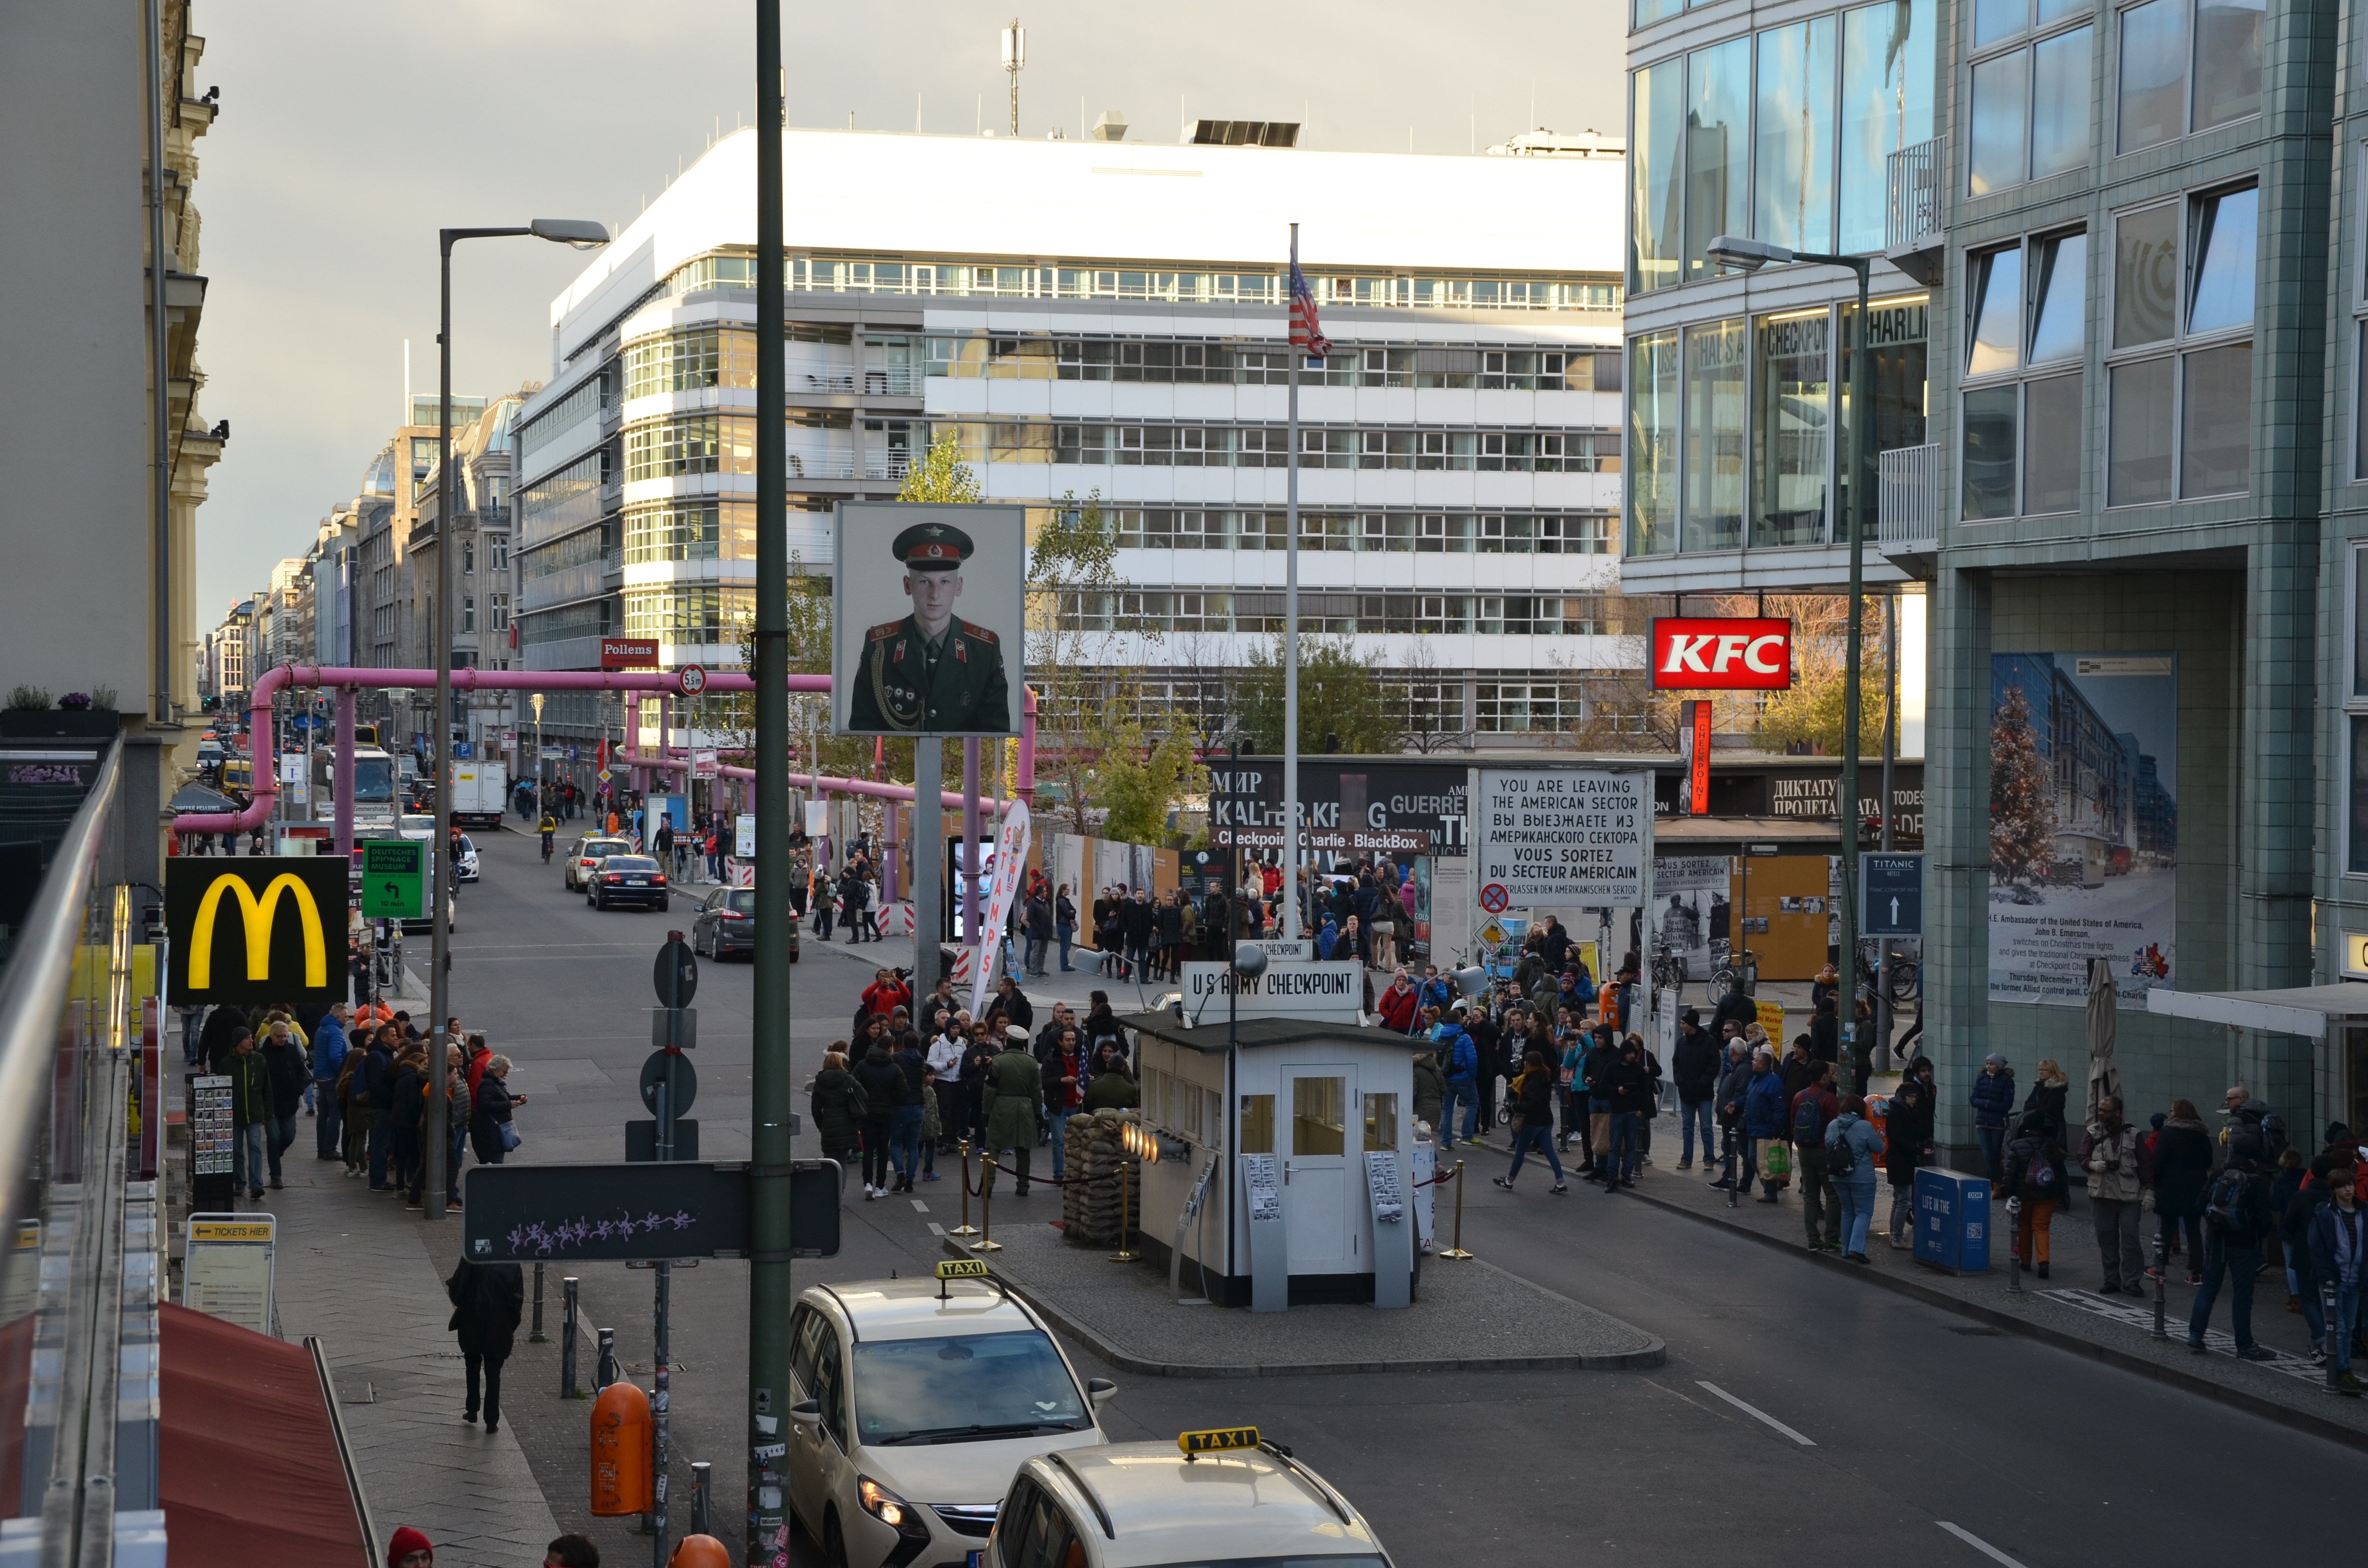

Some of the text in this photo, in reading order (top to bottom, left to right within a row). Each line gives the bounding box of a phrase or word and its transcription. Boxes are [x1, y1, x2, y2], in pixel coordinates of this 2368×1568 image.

[1768, 317, 1828, 356] CHECKPOI
[1866, 305, 1928, 344] HARLI
[604, 644, 652, 655] Pollems
[1660, 635, 1785, 674] KFC
[1695, 724, 1705, 801] CHECKPOINT
[1211, 772, 1262, 793] МИР
[1500, 779, 1631, 794] YOU ARE LEAVING
[1774, 779, 1837, 801] ДИКТАТУ
[1391, 795, 1464, 814] GUERRE
[1492, 796, 1638, 810] THE AMERICAN SECTOR
[1893, 790, 1924, 805] TODES
[1775, 798, 1881, 814] ПРОЛЕТААТА
[1493, 814, 1634, 828] ВЫ ВЫЕЗЖАЕТЕ ИЗ
[1219, 831, 1284, 848] Ceckpoin
[1354, 834, 1418, 848] BlackBox
[1490, 831, 1638, 844] АМЕРИКАНСКОГО СЕКТОРА
[1514, 848, 1613, 862] VOUS SORTEZ
[1490, 864, 1637, 879] DU SECTEUR AMÉRICAIN
[1682, 860, 1710, 869] SORTEZ
[1657, 868, 1724, 879] SECTEUR AMÉRICAIN
[1504, 885, 1637, 894] ERLASSEN DEN AMERIKANISCHEN SEKTOR
[982, 826, 1011, 973] STAMPS
[2001, 915, 2038, 925] Ambassador
[2060, 918, 2081, 926] United
[2083, 919, 2103, 927] States
[2113, 920, 2144, 930] America,
[1415, 921, 1430, 942] WAR
[2035, 928, 2090, 939] John B. Emerson,
[1266, 943, 1302, 956] CHECKPOINT
[2013, 938, 2039, 947] switches
[2050, 940, 2081, 949] Christmas
[2083, 941, 2095, 949] tree
[2096, 942, 2114, 951] lights
[2011, 949, 2026, 958] gives
[2039, 950, 2069, 959] traditional
[2070, 951, 2102, 960] Christmas
[2104, 954, 2129, 962] address
[2036, 960, 2071, 971] Checkpoint
[2072, 962, 2087, 971] Char
[1268, 973, 1352, 995] CHECKPOINT
[2009, 973, 2039, 983] Thursday,
[2040, 974, 2073, 984] December
[2074, 977, 2081, 985] 1,
[2001, 983, 2022, 992] former
[2023, 984, 2040, 993] Allied
[2042, 986, 2064, 995] control
[2066, 987, 2082, 997] post,
[2122, 991, 2147, 1000] Charlie
[1761, 1005, 1777, 1014] Berlin
[1765, 1016, 1783, 1025] Market
[1922, 1195, 1949, 1214] LIFE IN THE
[214, 1227, 269, 1236] TICKETS HIER
[1931, 1216, 1940, 1232] GDR
[944, 1262, 981, 1274] TAXI
[1196, 1431, 1248, 1448] TAXI
